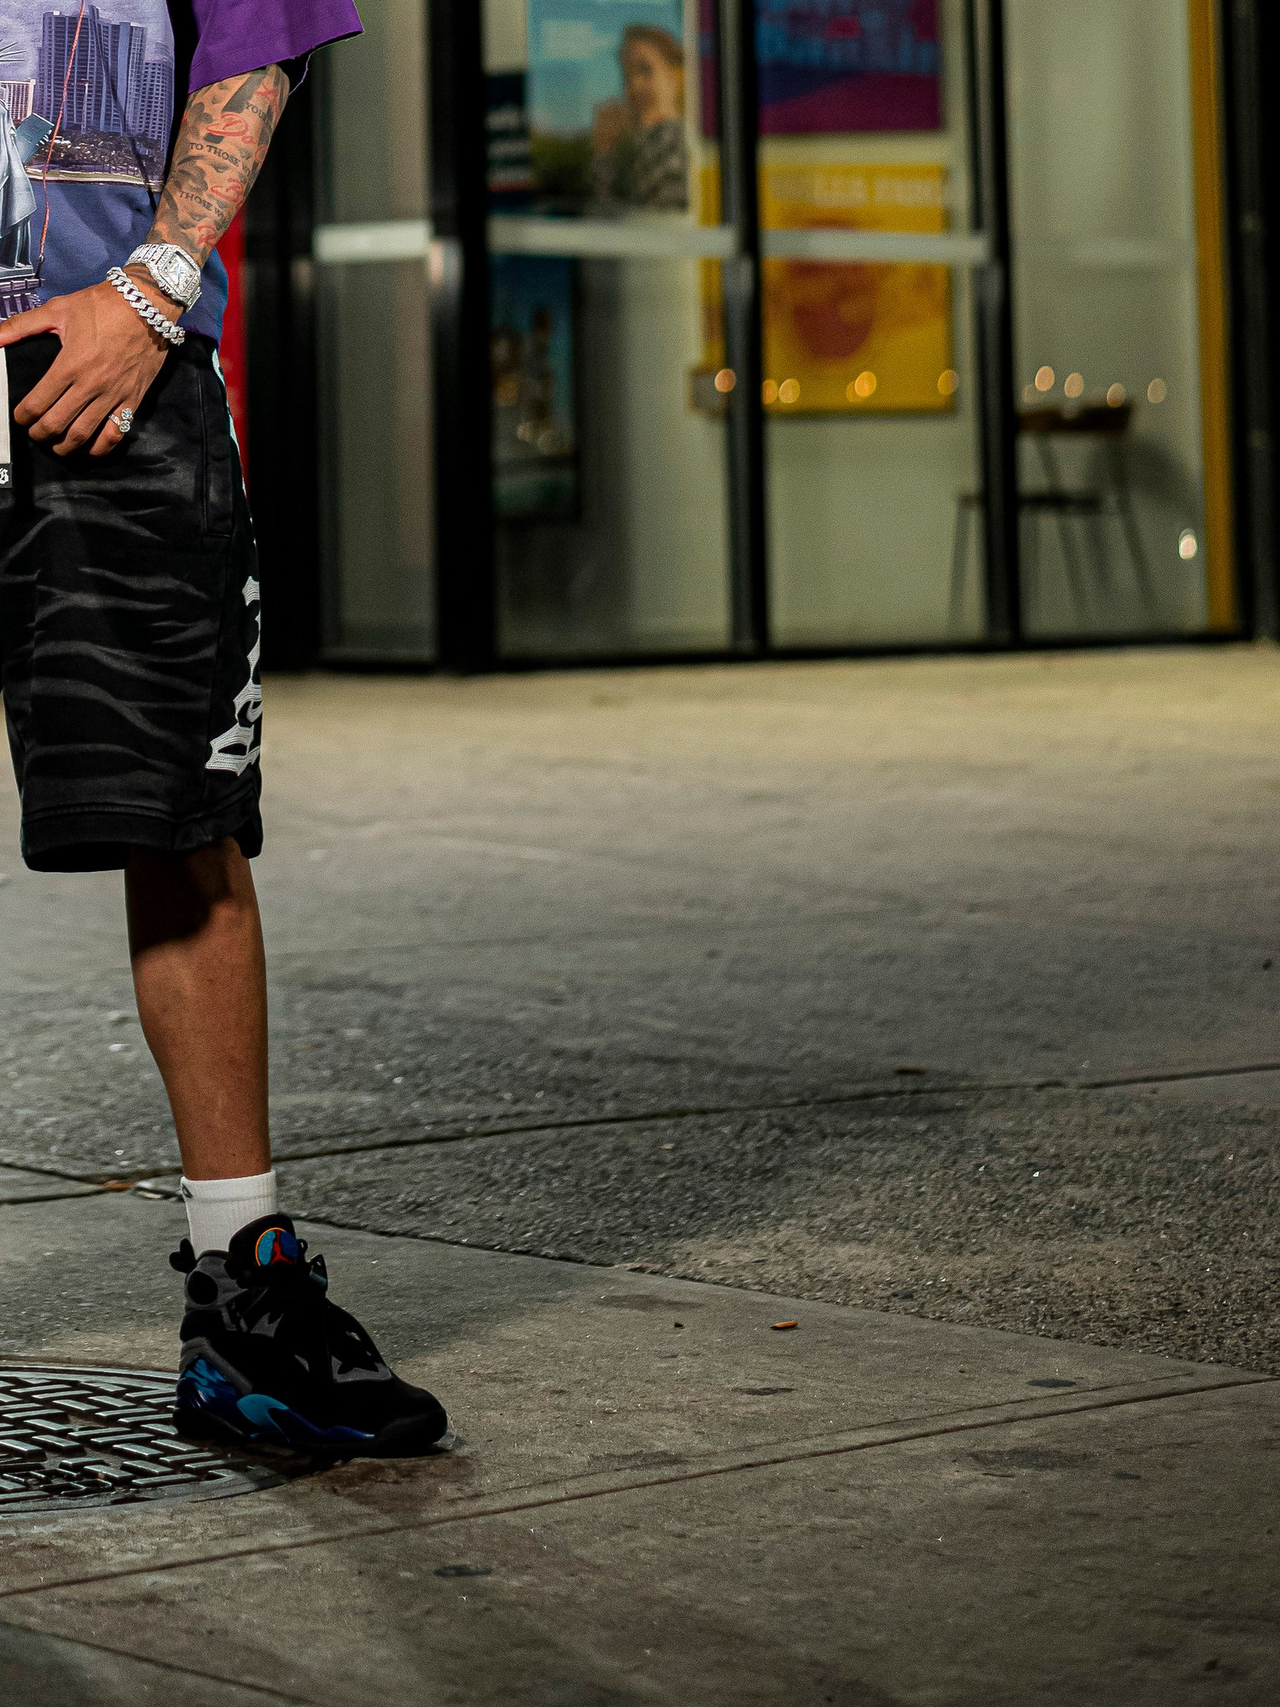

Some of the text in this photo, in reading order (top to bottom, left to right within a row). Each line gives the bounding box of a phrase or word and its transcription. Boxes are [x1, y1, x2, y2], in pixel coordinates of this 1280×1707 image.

[189, 142, 203, 151] TO
[206, 144, 241, 167] THOSE
[179, 191, 212, 212] THOSE
